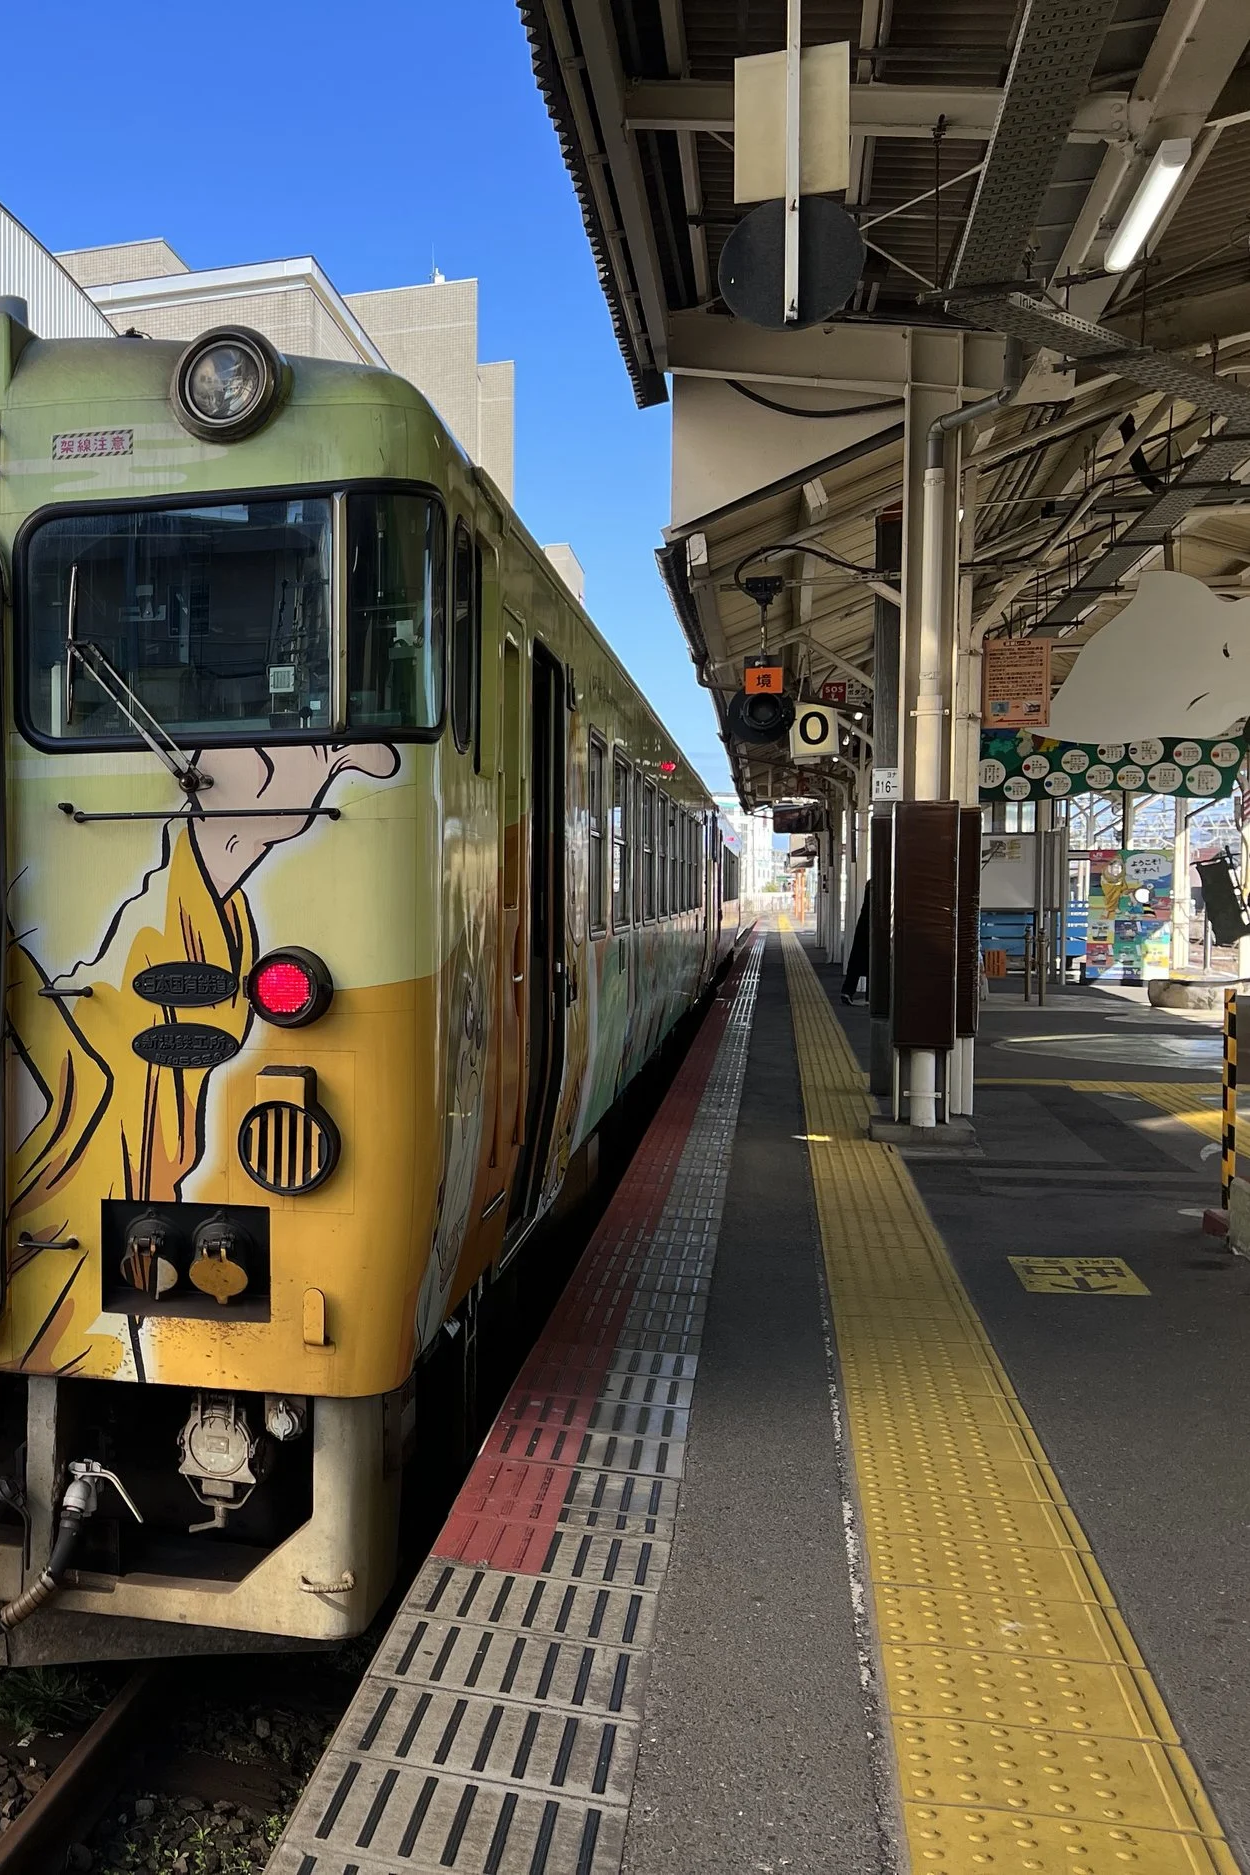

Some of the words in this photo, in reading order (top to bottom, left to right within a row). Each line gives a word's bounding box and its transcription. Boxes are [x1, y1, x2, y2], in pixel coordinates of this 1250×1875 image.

[60, 435, 125, 454] 架線注意
[756, 673, 772, 688] 境
[825, 685, 845, 693] SOS
[142, 974, 228, 995] 日本国有鉄道
